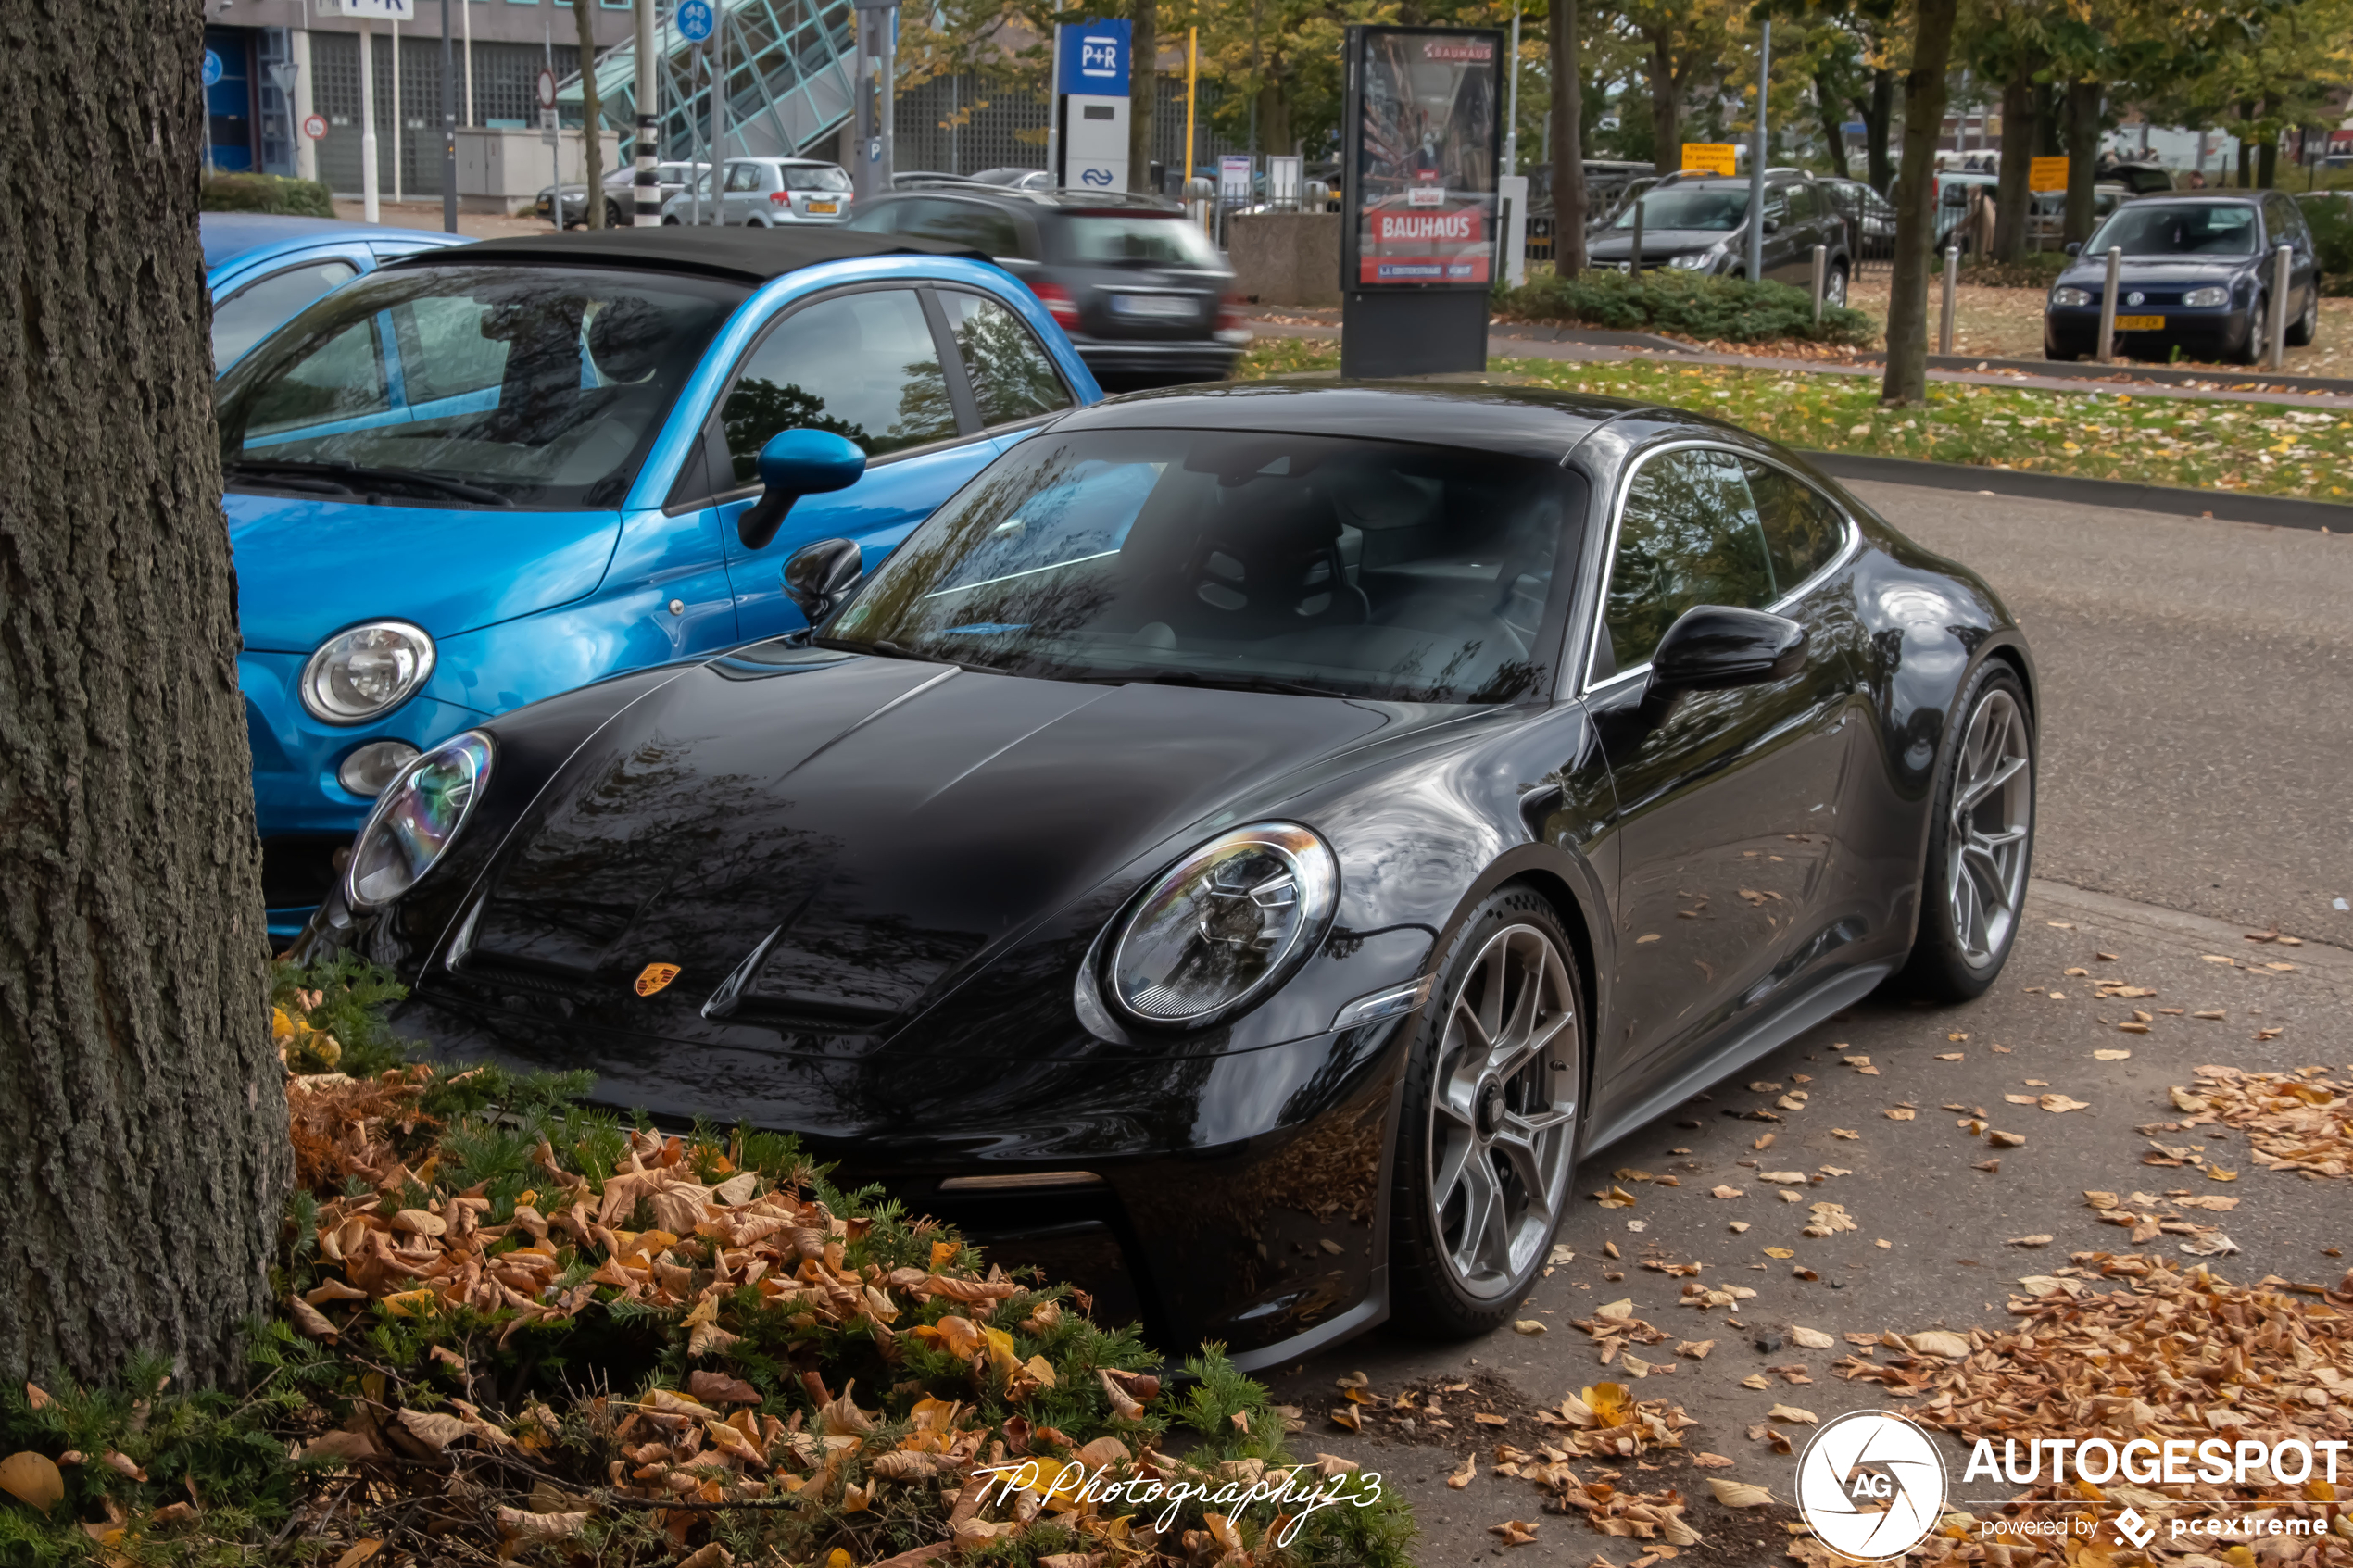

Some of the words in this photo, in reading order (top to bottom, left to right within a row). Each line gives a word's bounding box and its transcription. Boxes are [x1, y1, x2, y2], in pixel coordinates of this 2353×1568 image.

[1082, 44, 1116, 69] P+R
[1434, 46, 1491, 59] BAUHAUS
[871, 142, 881, 159] P
[1382, 216, 1471, 239] BAUHAUS
